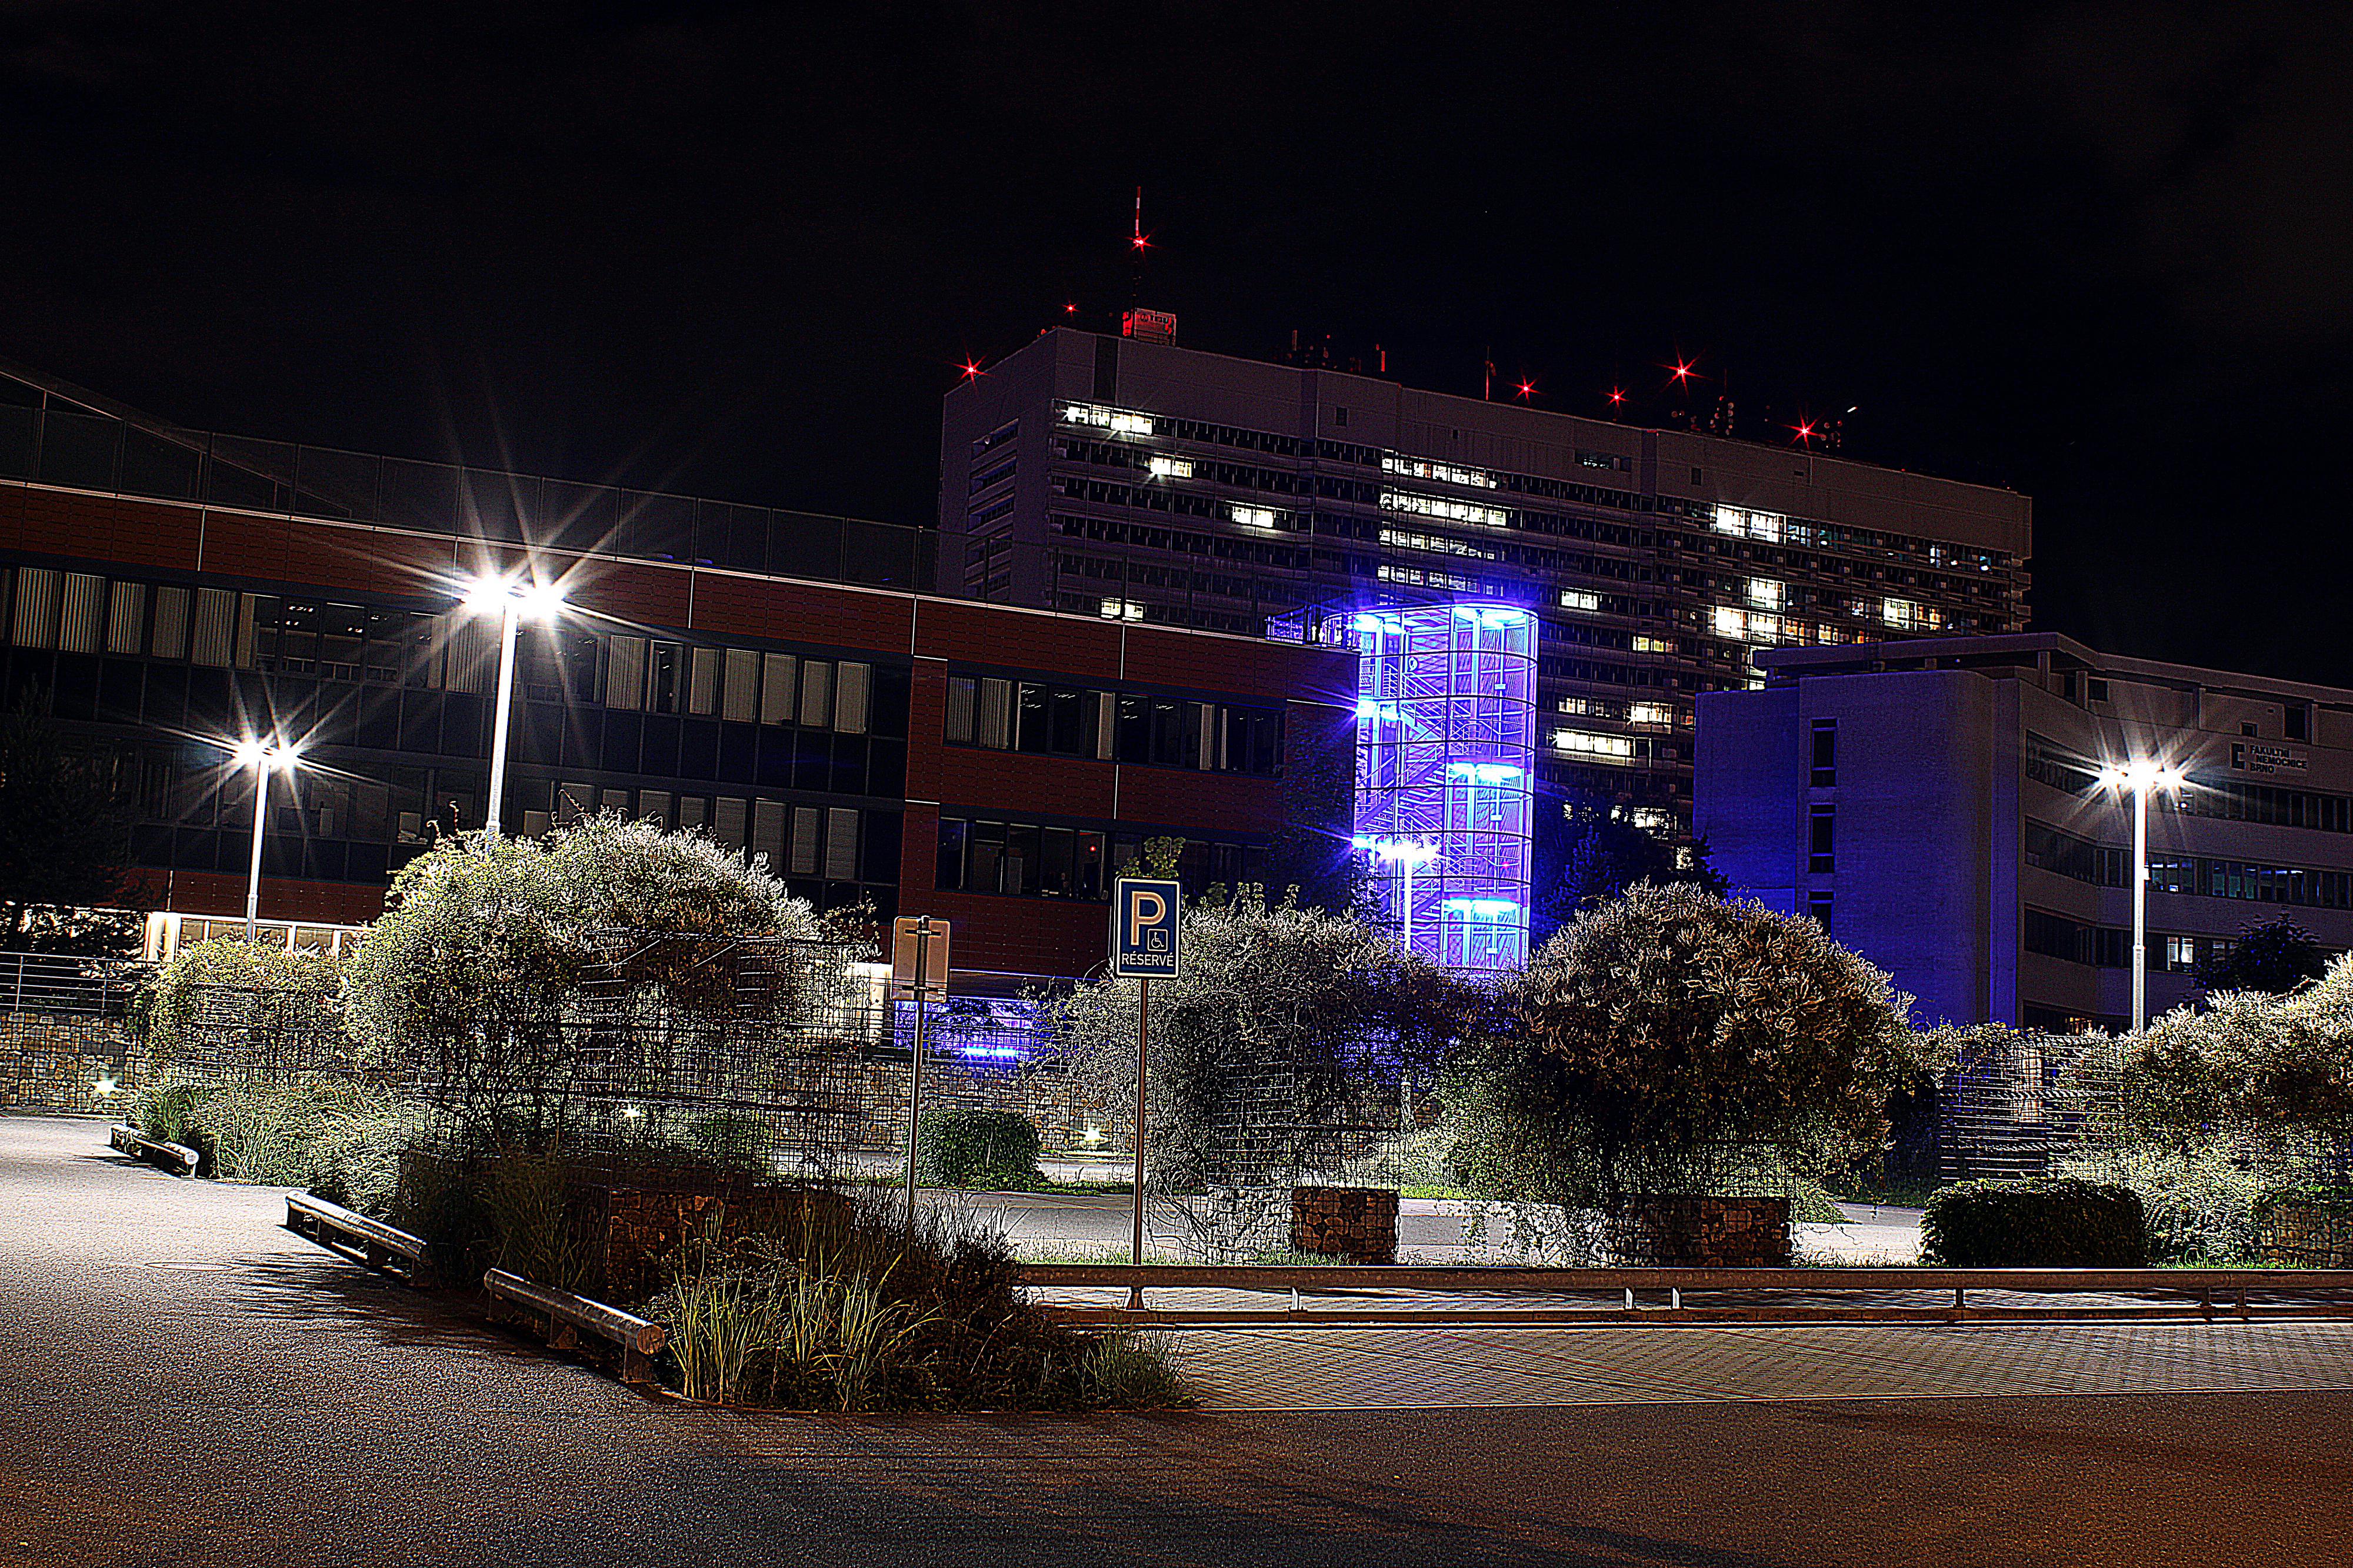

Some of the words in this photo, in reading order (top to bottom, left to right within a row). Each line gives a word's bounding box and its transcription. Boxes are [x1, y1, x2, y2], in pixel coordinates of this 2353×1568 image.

[2250, 763, 2275, 773] BRNO
[2257, 755, 2307, 769] NEMOCNICE
[1131, 891, 1166, 945] P
[1122, 950, 1174, 966] RÉSERVÉ
